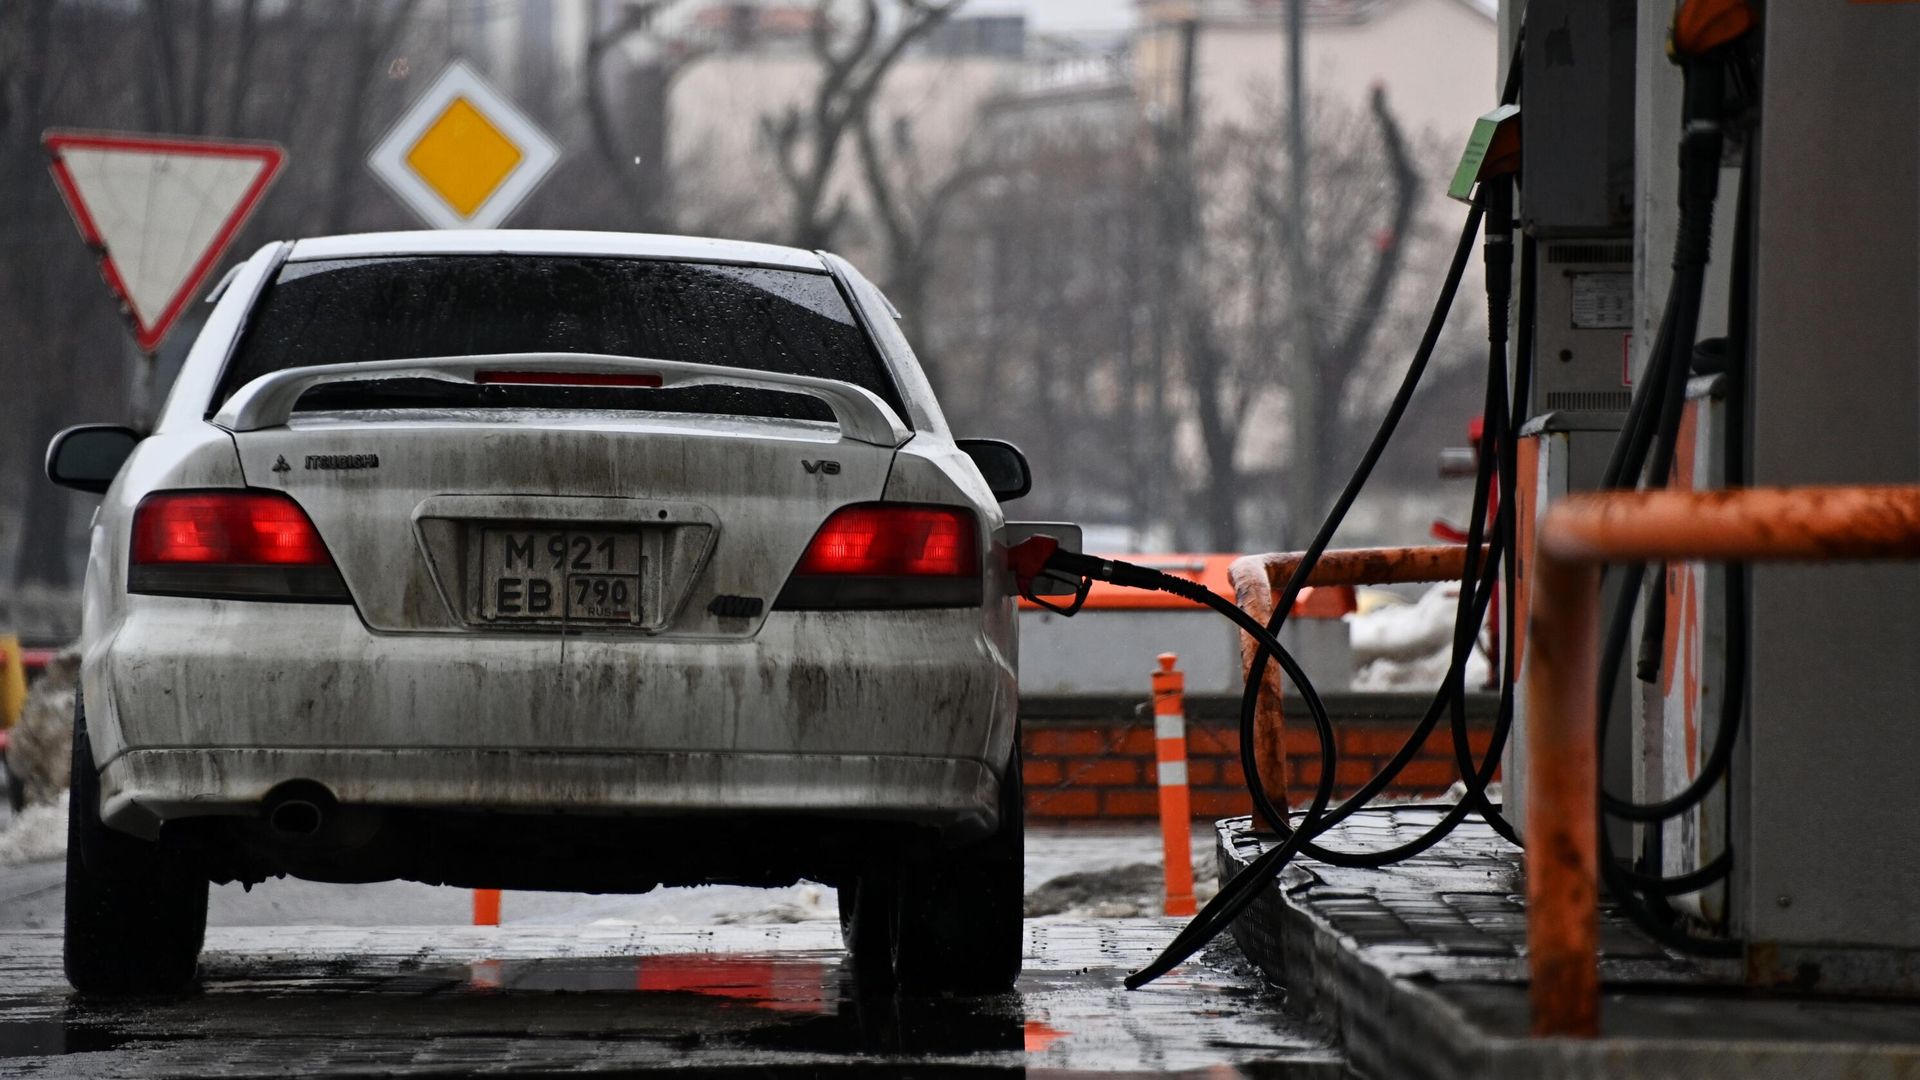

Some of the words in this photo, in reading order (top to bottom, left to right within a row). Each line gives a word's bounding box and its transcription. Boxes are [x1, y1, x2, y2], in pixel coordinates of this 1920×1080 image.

[801, 460, 841, 475] V6
[548, 535, 616, 570] 921
[574, 579, 628, 606] 790
[588, 606, 612, 617] RUS
